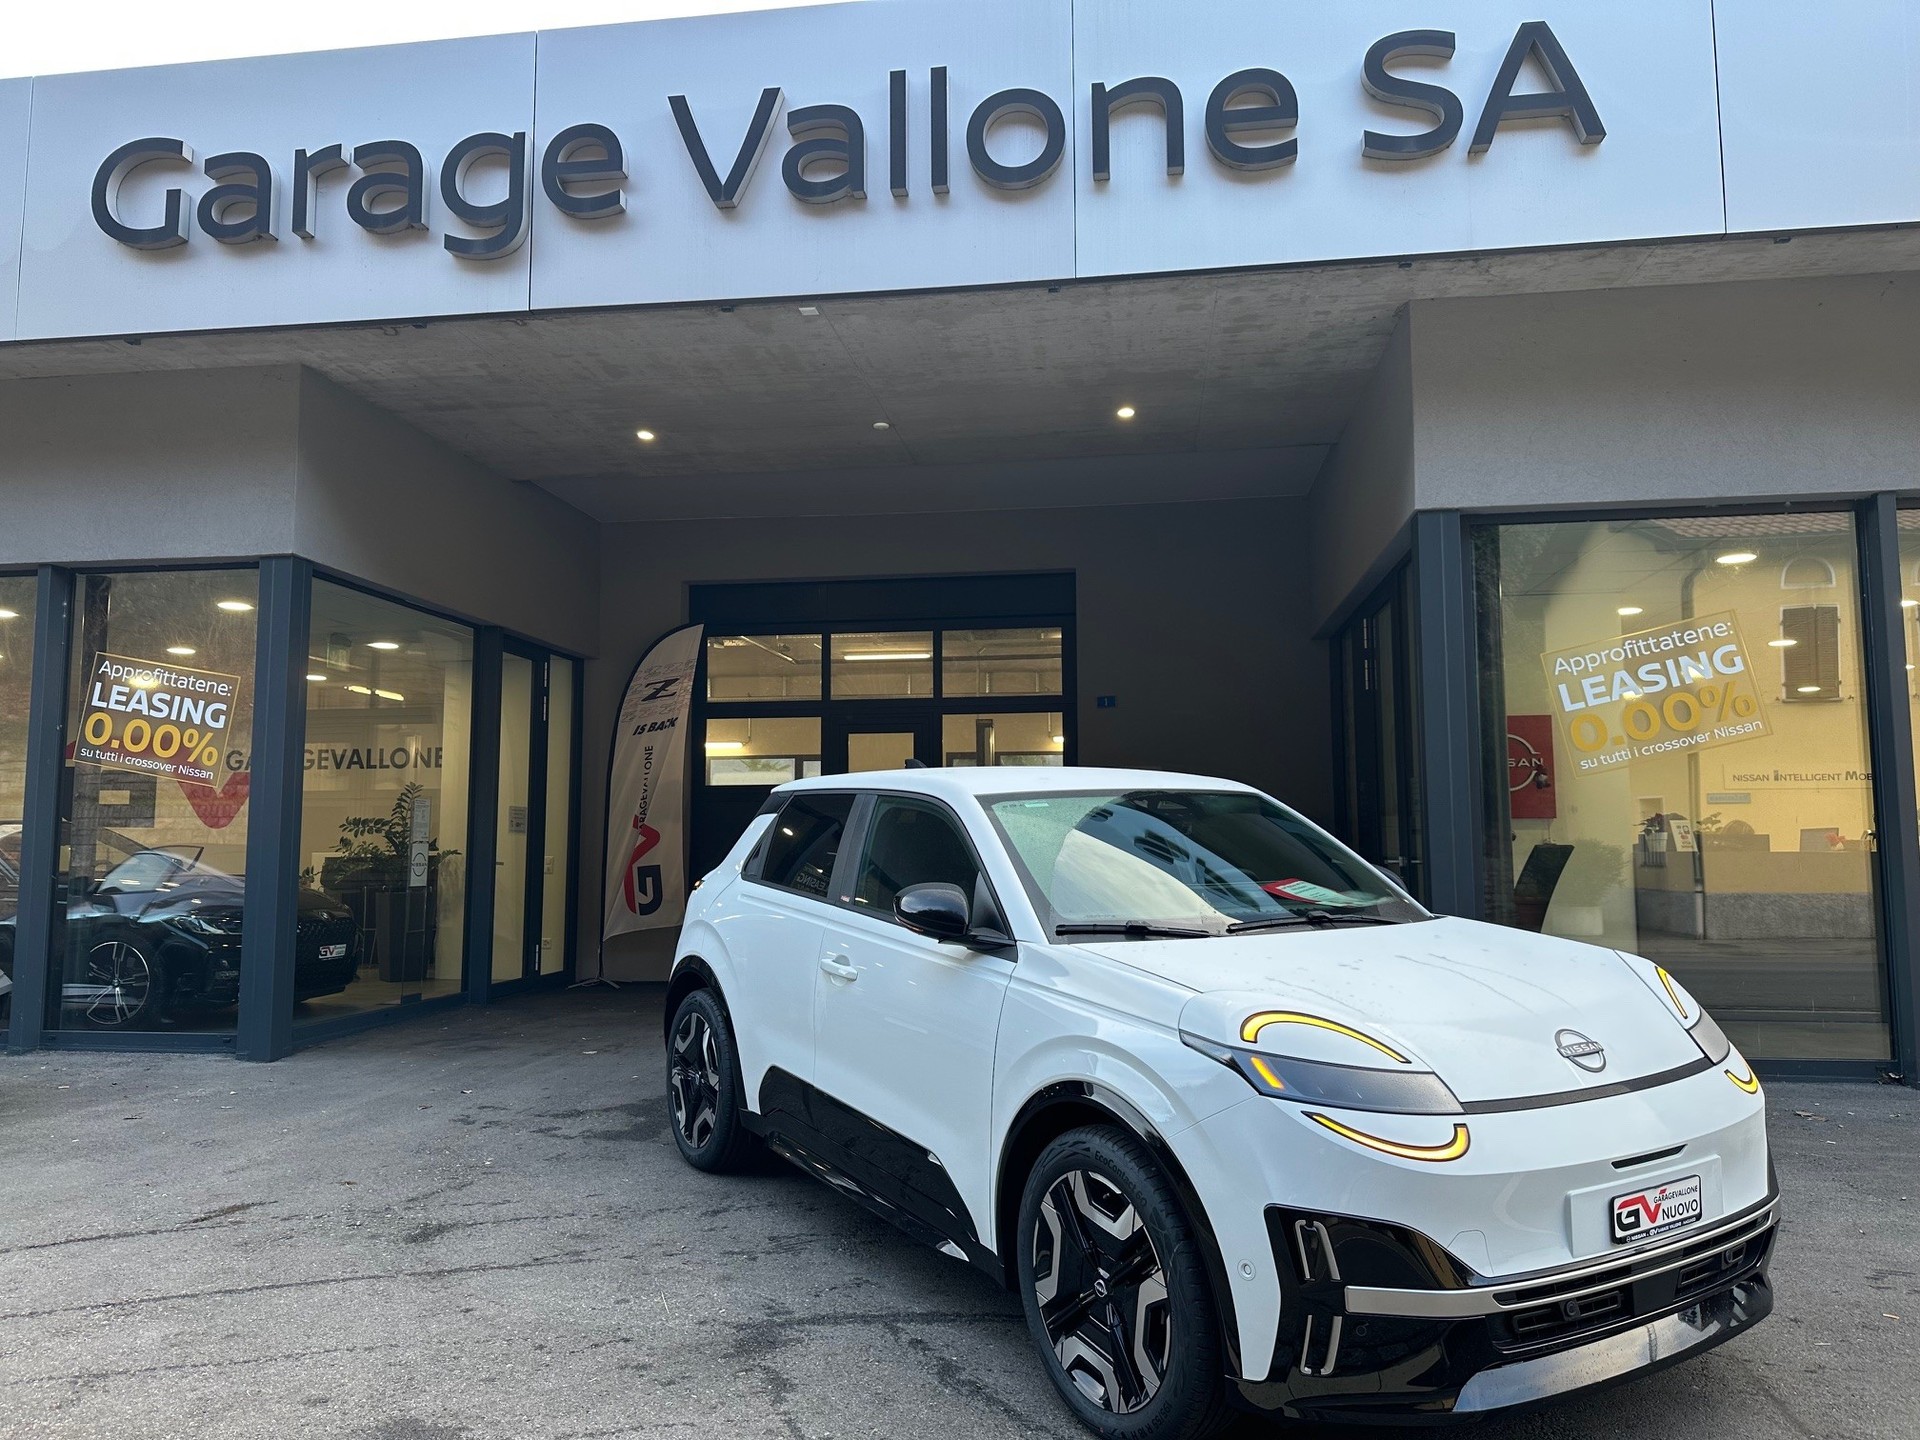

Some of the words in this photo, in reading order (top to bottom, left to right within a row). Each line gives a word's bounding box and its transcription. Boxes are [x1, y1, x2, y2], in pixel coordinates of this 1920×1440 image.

[91, 123, 628, 259] Garage
[668, 66, 1299, 208] Vallone
[1361, 20, 1607, 160] SA
[1554, 621, 1735, 676] Approfittatene:
[98, 660, 233, 697] Approfittatene:
[1557, 643, 1745, 713] LEASING
[91, 681, 228, 729] LEASING
[1570, 681, 1757, 752] 0.00%
[85, 711, 219, 767] 0.00%
[632, 723, 648, 736] IS
[1580, 757, 1598, 770] su
[1600, 748, 1631, 765] tutti
[1634, 746, 1639, 758] i
[1641, 732, 1710, 756] crossover
[1714, 720, 1763, 739] Nissan
[80, 747, 94, 758] su
[95, 748, 118, 763] tutti
[119, 753, 124, 763] i
[125, 756, 177, 773] crossover
[178, 765, 214, 780] Nissan
[1732, 773, 1770, 782] NISSAN
[1560, 1042, 1602, 1056] NISSAN
[1653, 1185, 1698, 1204] GARAGEVALLONE
[1662, 1199, 1699, 1221] NUOVO
